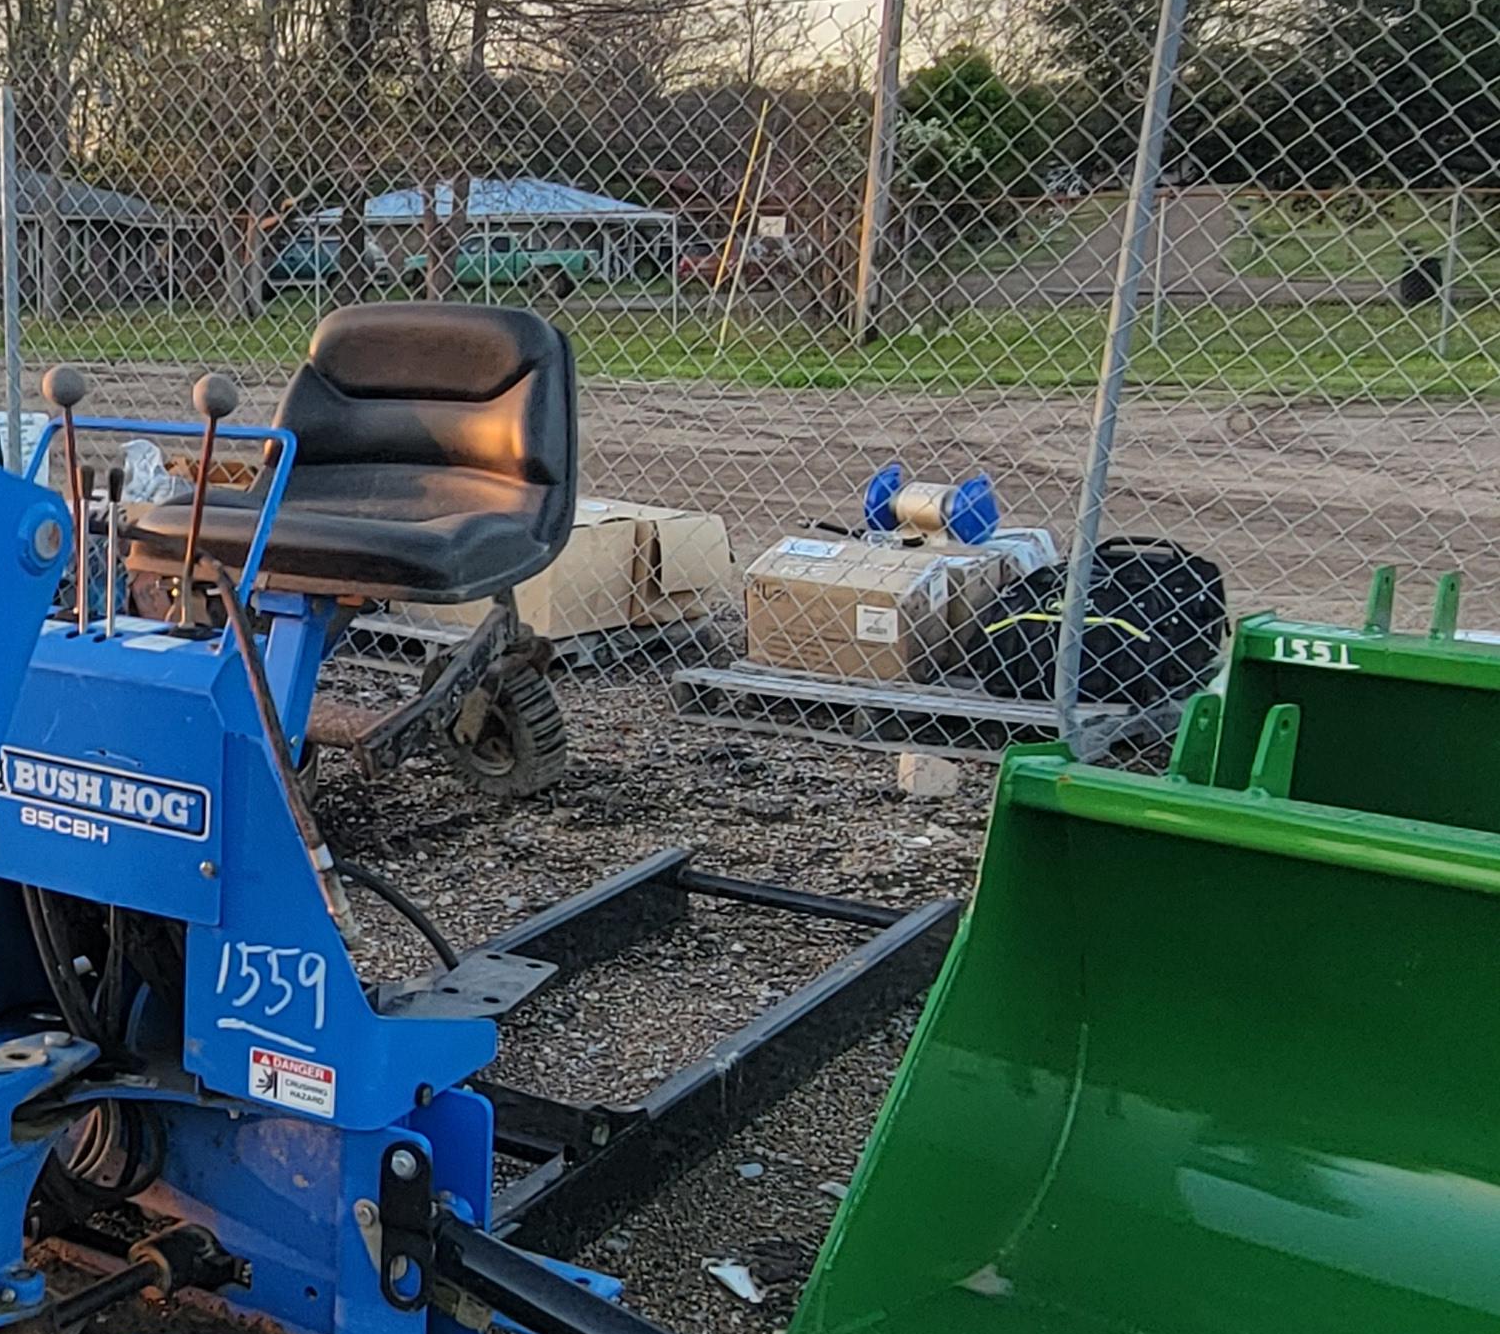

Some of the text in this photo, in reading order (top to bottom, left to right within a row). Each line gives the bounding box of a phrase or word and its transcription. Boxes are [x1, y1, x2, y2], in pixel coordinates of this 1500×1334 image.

[1273, 635, 1349, 666] 1551
[13, 759, 190, 825] BUSH HOG
[20, 805, 110, 845] 85CBH
[215, 941, 327, 1030] 1559
[272, 1055, 325, 1080] DANGER
[289, 1089, 325, 1105] HAZARD
